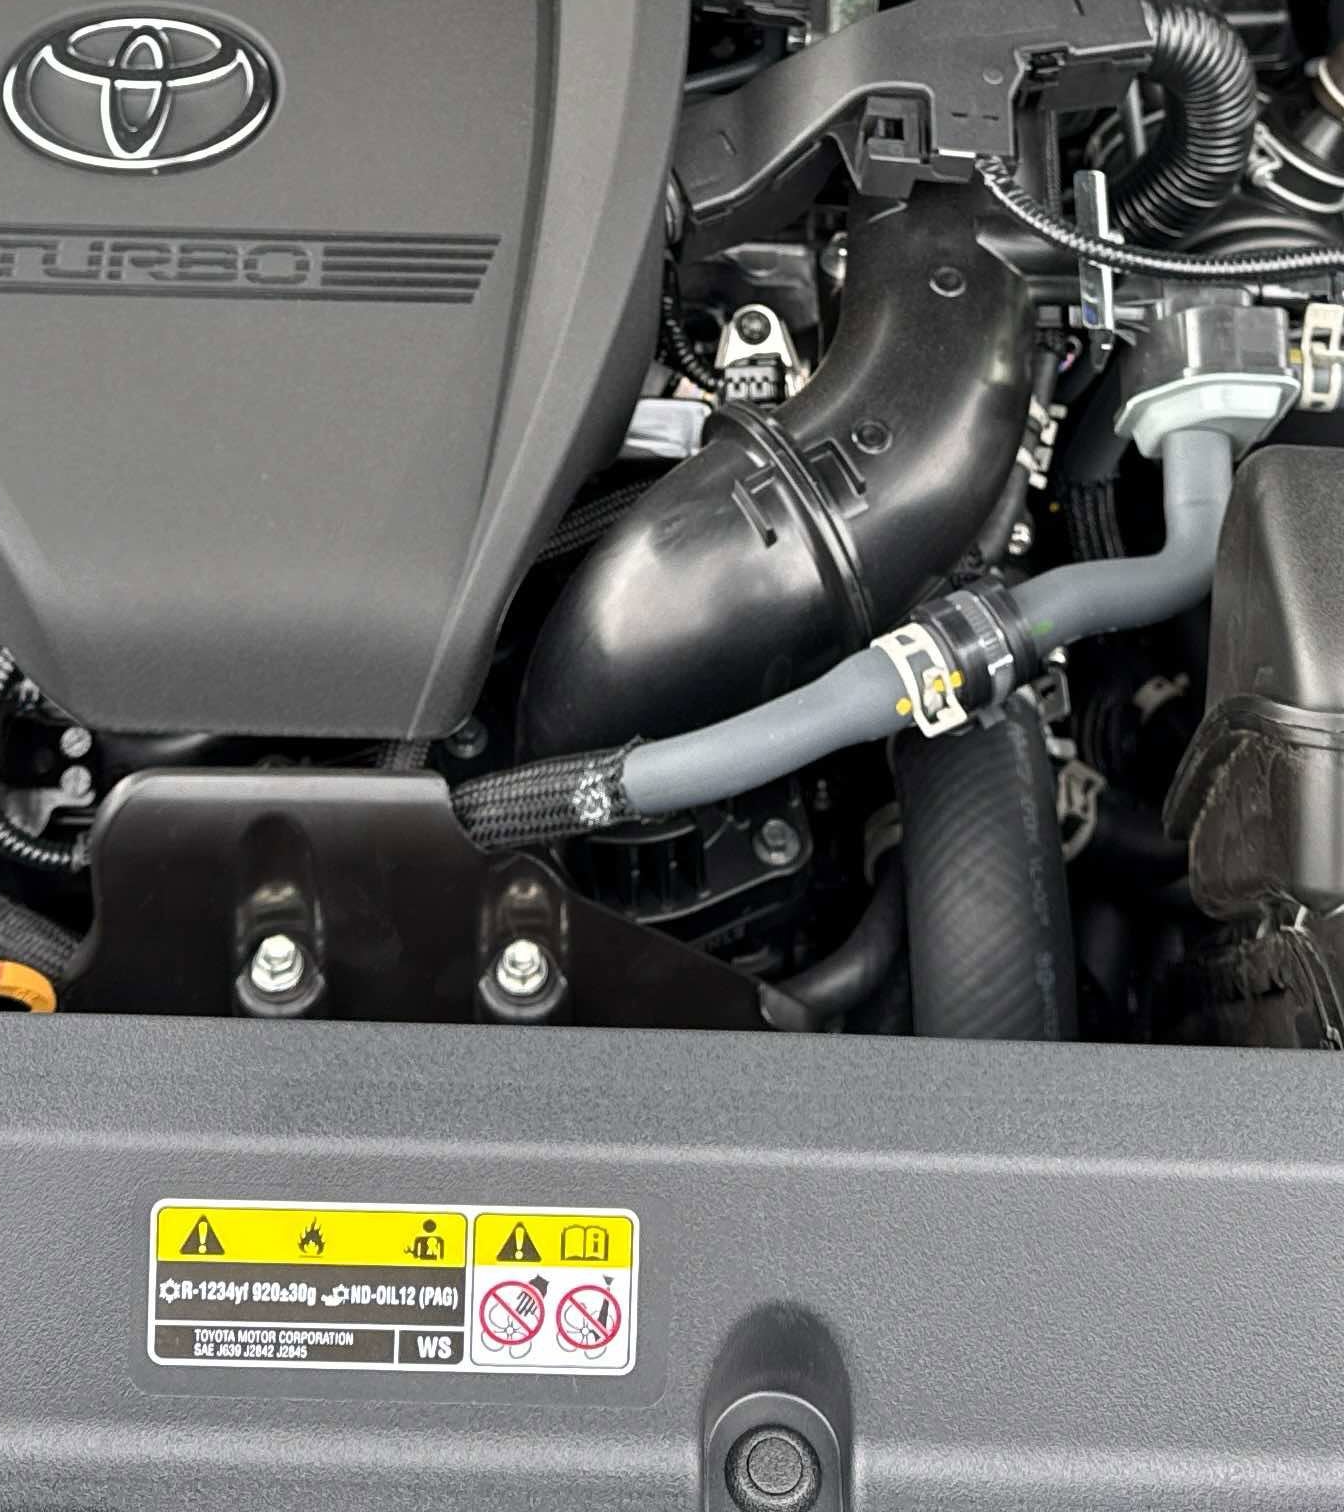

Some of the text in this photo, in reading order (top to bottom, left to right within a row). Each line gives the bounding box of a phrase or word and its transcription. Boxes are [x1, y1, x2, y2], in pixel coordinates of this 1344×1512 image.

[181, 1280, 459, 1310] R-1234yf 920±30g ND-OIL12 (PAG)
[194, 1328, 354, 1346] TOYOTA MOTOR CORPORATION
[193, 1343, 308, 1359] SAE J639 J2842 J2845
[417, 1336, 452, 1359] WS
